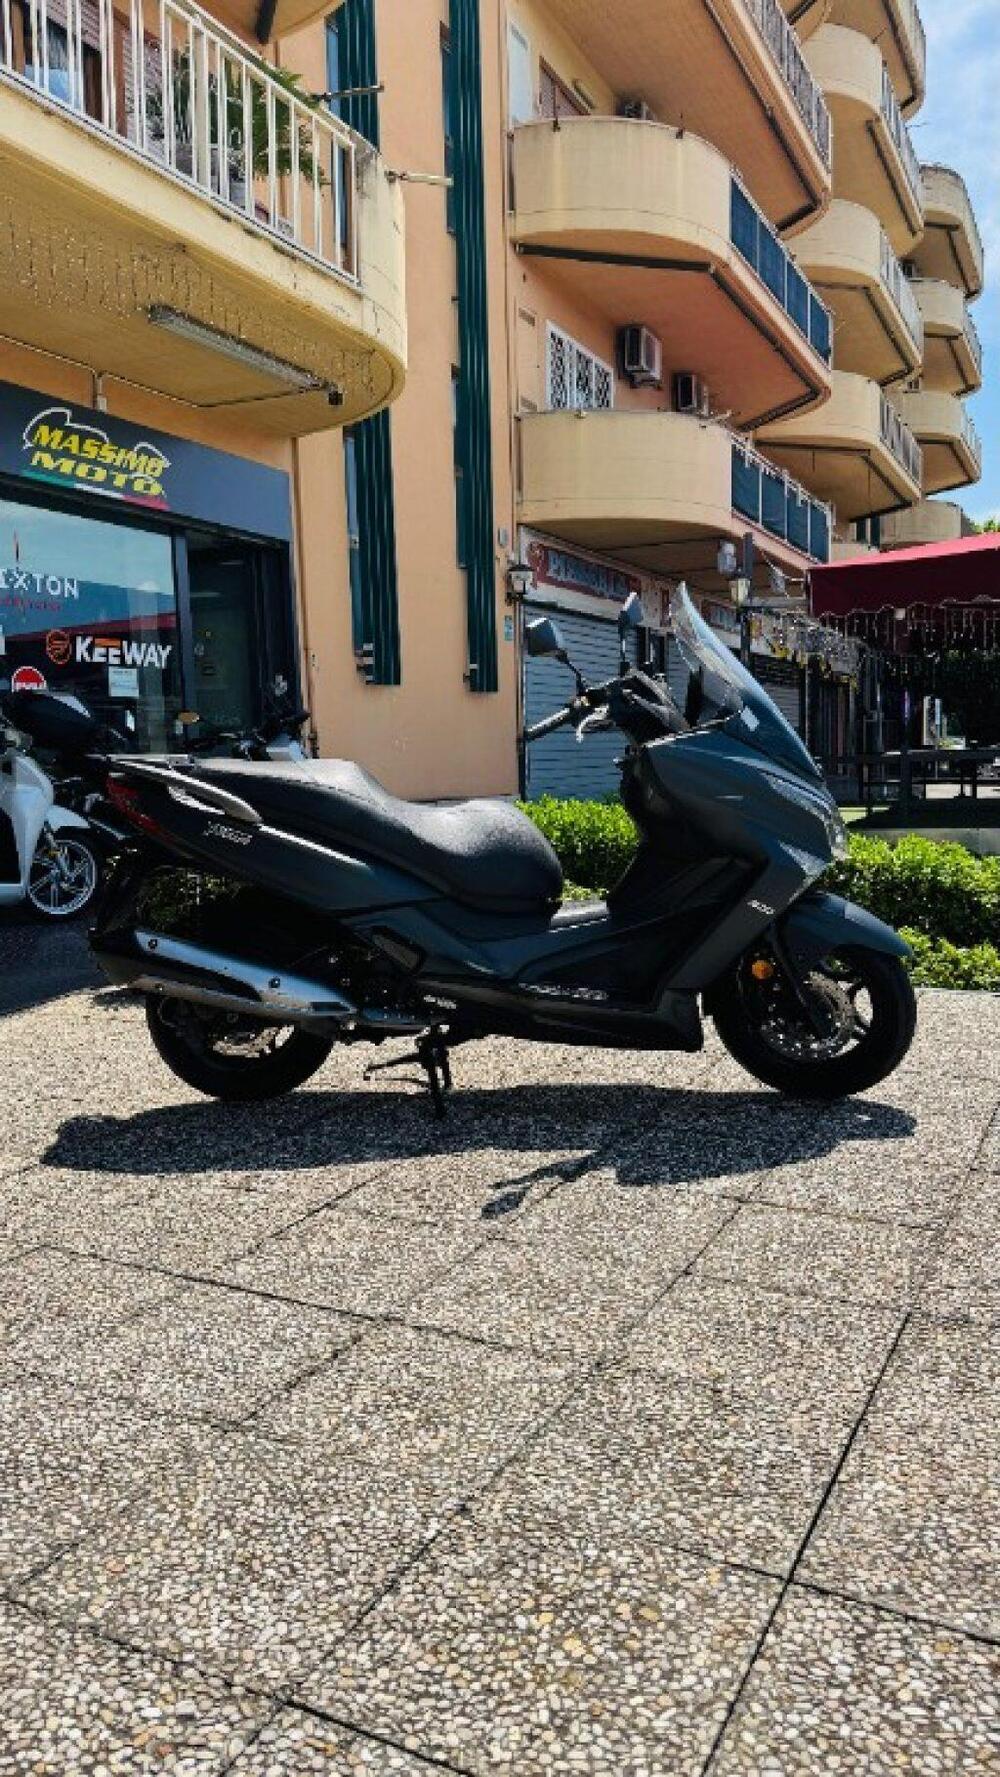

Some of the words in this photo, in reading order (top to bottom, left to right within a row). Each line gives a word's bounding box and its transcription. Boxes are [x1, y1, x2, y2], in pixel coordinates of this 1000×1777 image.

[31, 451, 163, 496] MOTO
[32, 424, 164, 478] MASSIMO
[75, 635, 172, 669] KEEWAY
